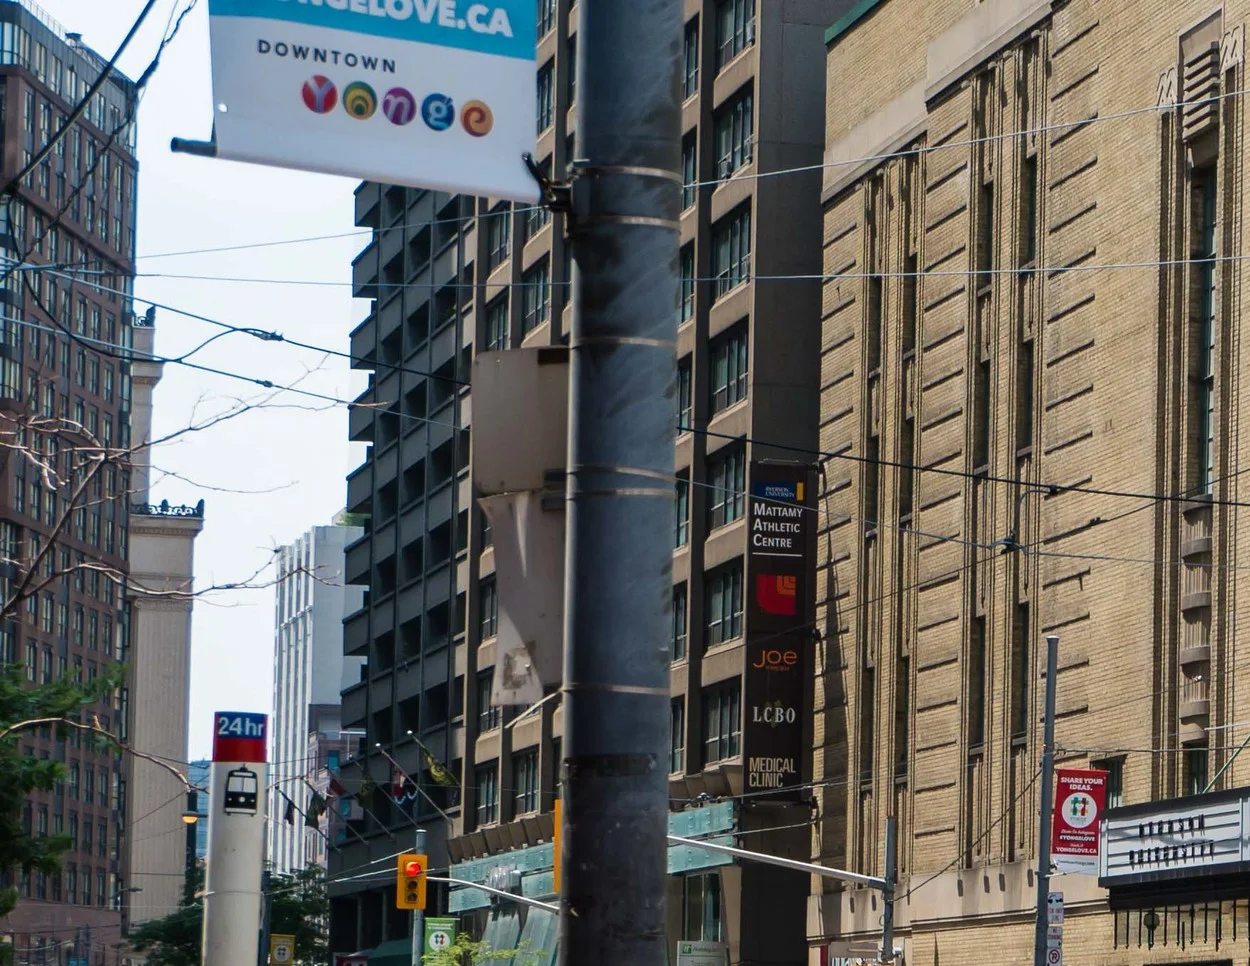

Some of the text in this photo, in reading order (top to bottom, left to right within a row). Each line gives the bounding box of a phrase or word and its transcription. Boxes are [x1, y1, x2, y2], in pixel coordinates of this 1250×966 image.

[258, 39, 396, 73] DOWNTOWN
[753, 706, 796, 723] LCBO
[749, 757, 796, 773] MEDICAL
[749, 772, 783, 788] CLINIC
